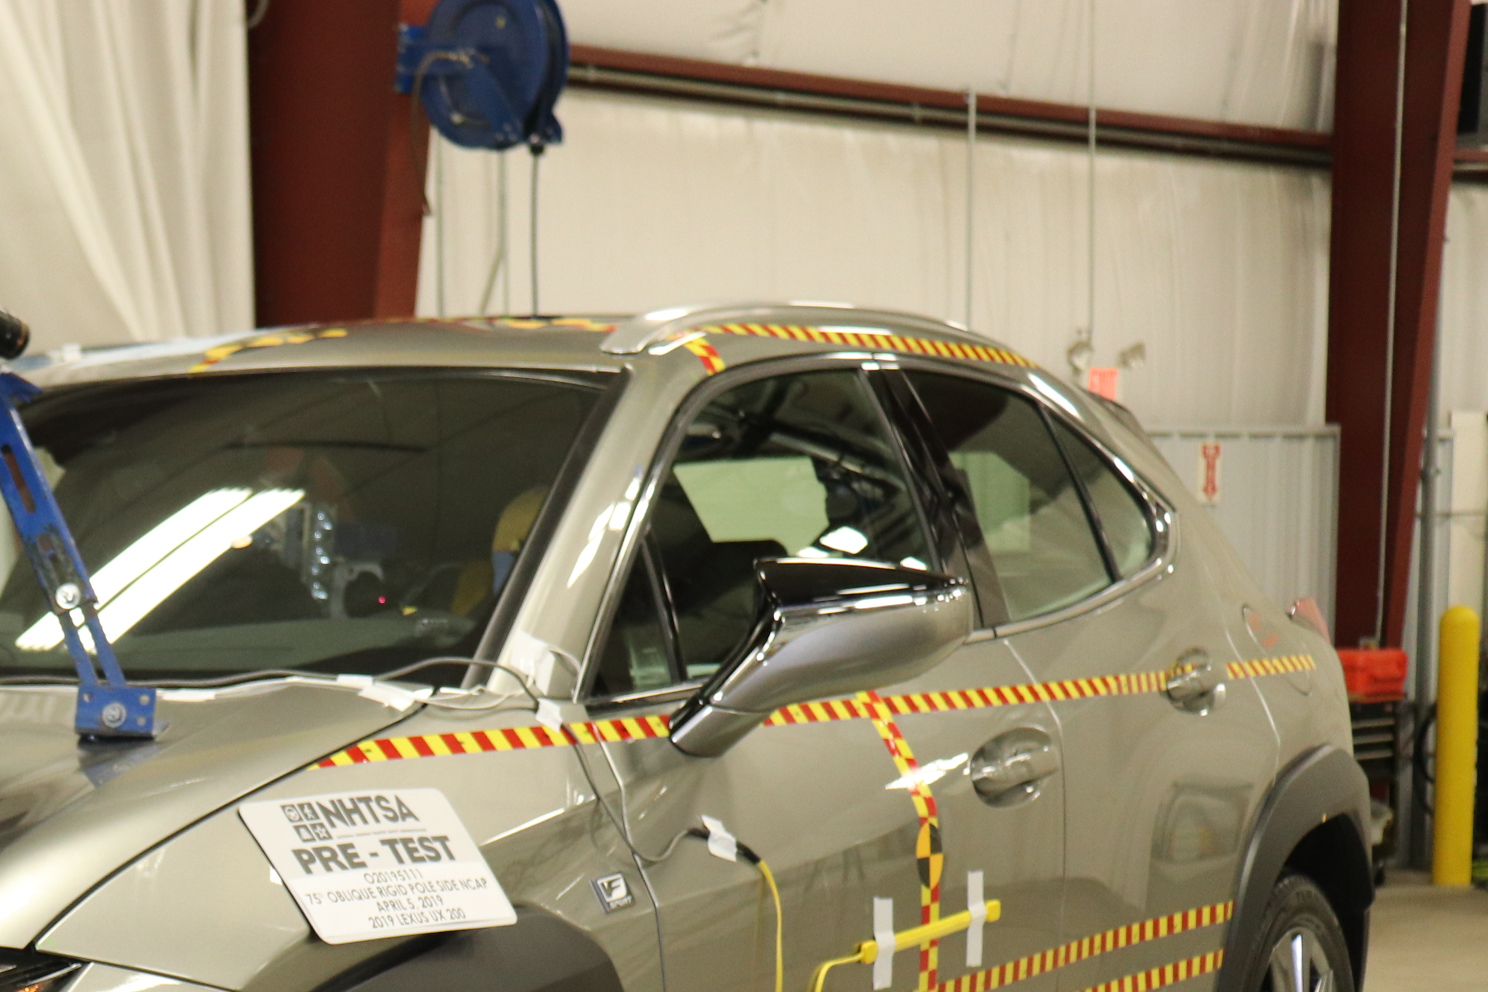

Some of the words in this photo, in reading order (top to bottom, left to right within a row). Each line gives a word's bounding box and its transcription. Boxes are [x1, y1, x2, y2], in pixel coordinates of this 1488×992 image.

[316, 794, 420, 829] NHTSA
[291, 842, 368, 875] PRE
[379, 835, 456, 865] TEST
[327, 887, 377, 903] OBLIQUE
[376, 884, 408, 898] RIGID
[408, 881, 437, 895] POLE
[436, 879, 459, 892] SIDE
[458, 877, 487, 891] NCAP
[376, 899, 407, 913] APRIL
[418, 894, 444, 908] 2019
[368, 914, 394, 929] 2019
[396, 911, 429, 926] LEXUS
[428, 909, 447, 922] UX
[446, 907, 466, 920] 200
